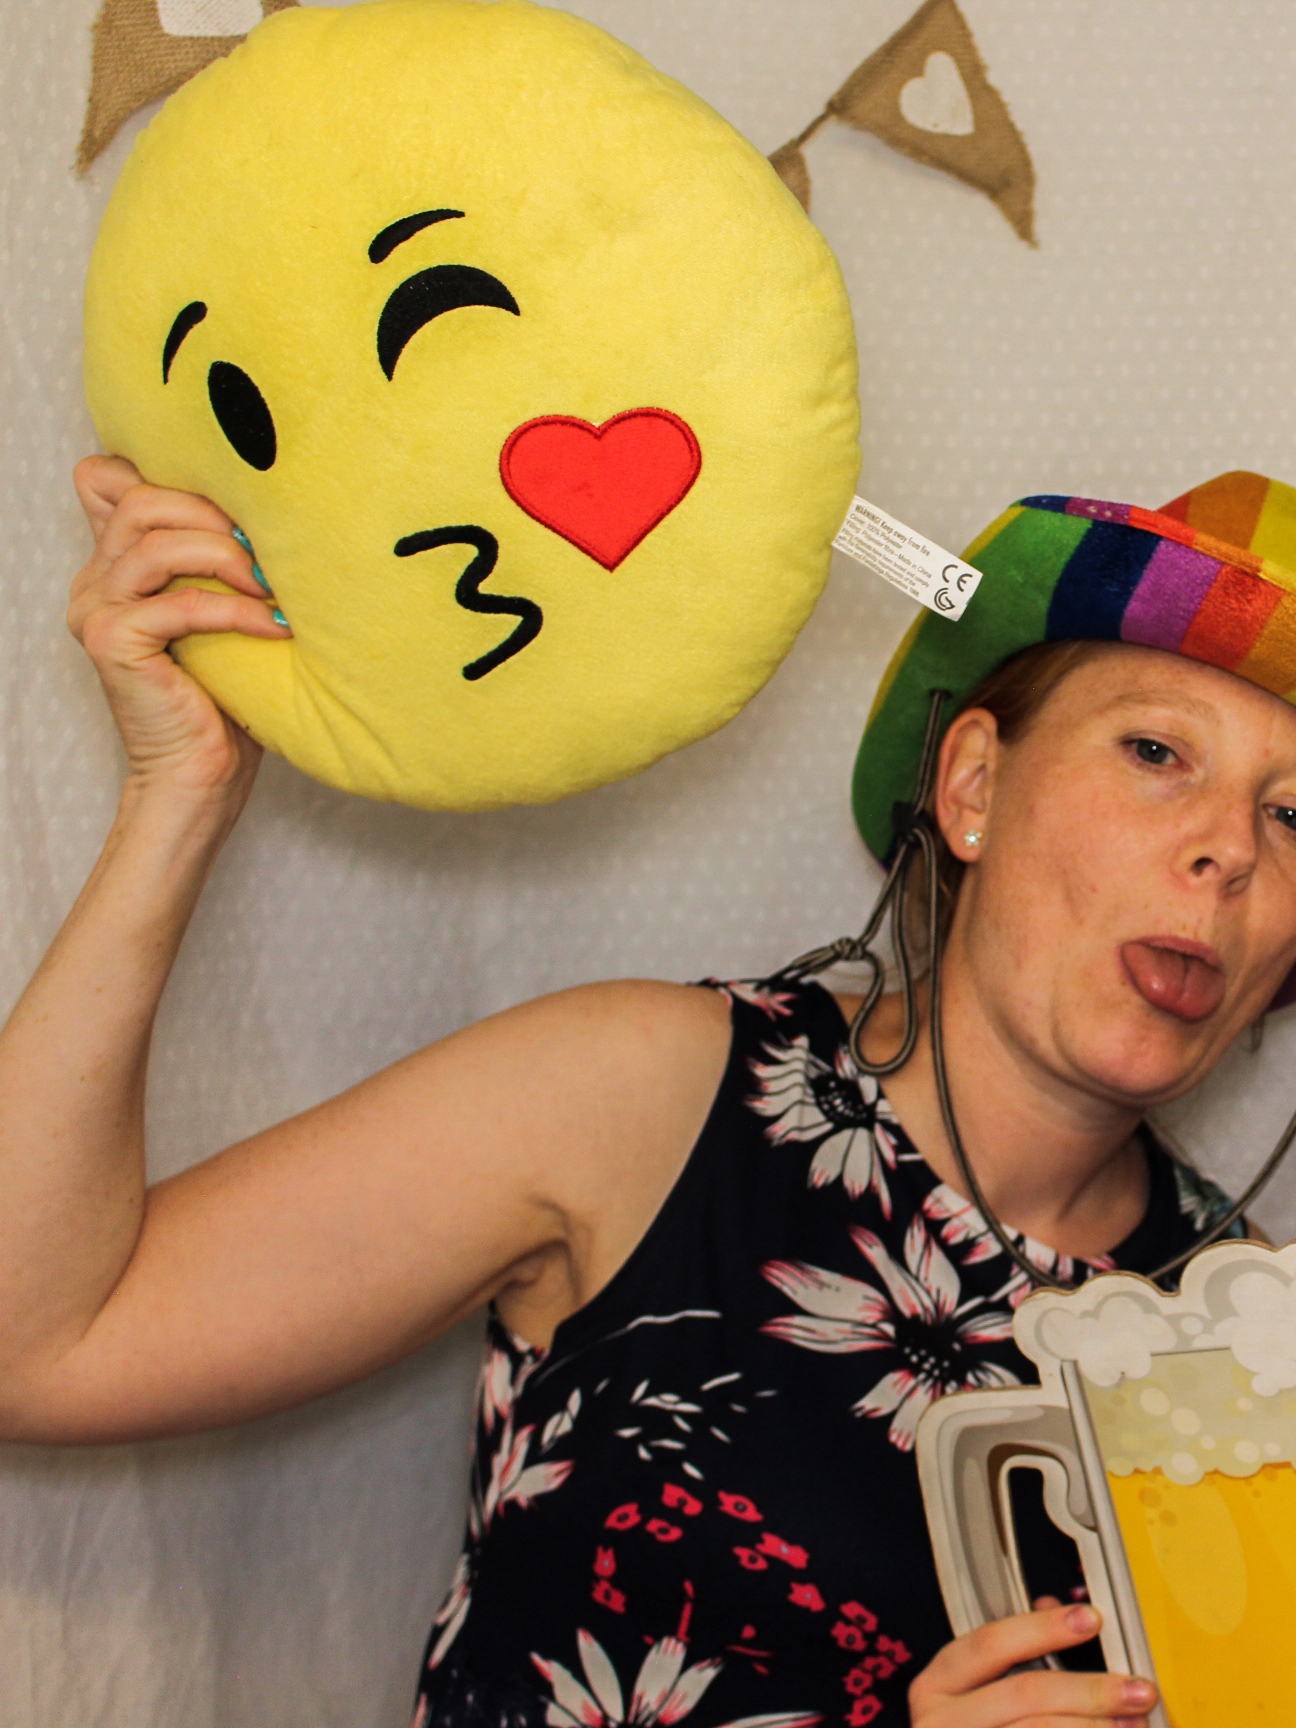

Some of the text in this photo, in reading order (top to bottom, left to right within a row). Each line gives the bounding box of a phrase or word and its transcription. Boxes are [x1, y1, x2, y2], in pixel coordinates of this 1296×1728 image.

[853, 503, 932, 556] WARNING! Keep away from fire
[866, 523, 881, 535] 100%
[878, 531, 903, 550] Polyester
[860, 529, 884, 548] Polyester
[897, 553, 912, 565] Made
[916, 565, 933, 578] China
[905, 569, 915, 578] and
[907, 579, 916, 587] the
[942, 564, 973, 592] CE
